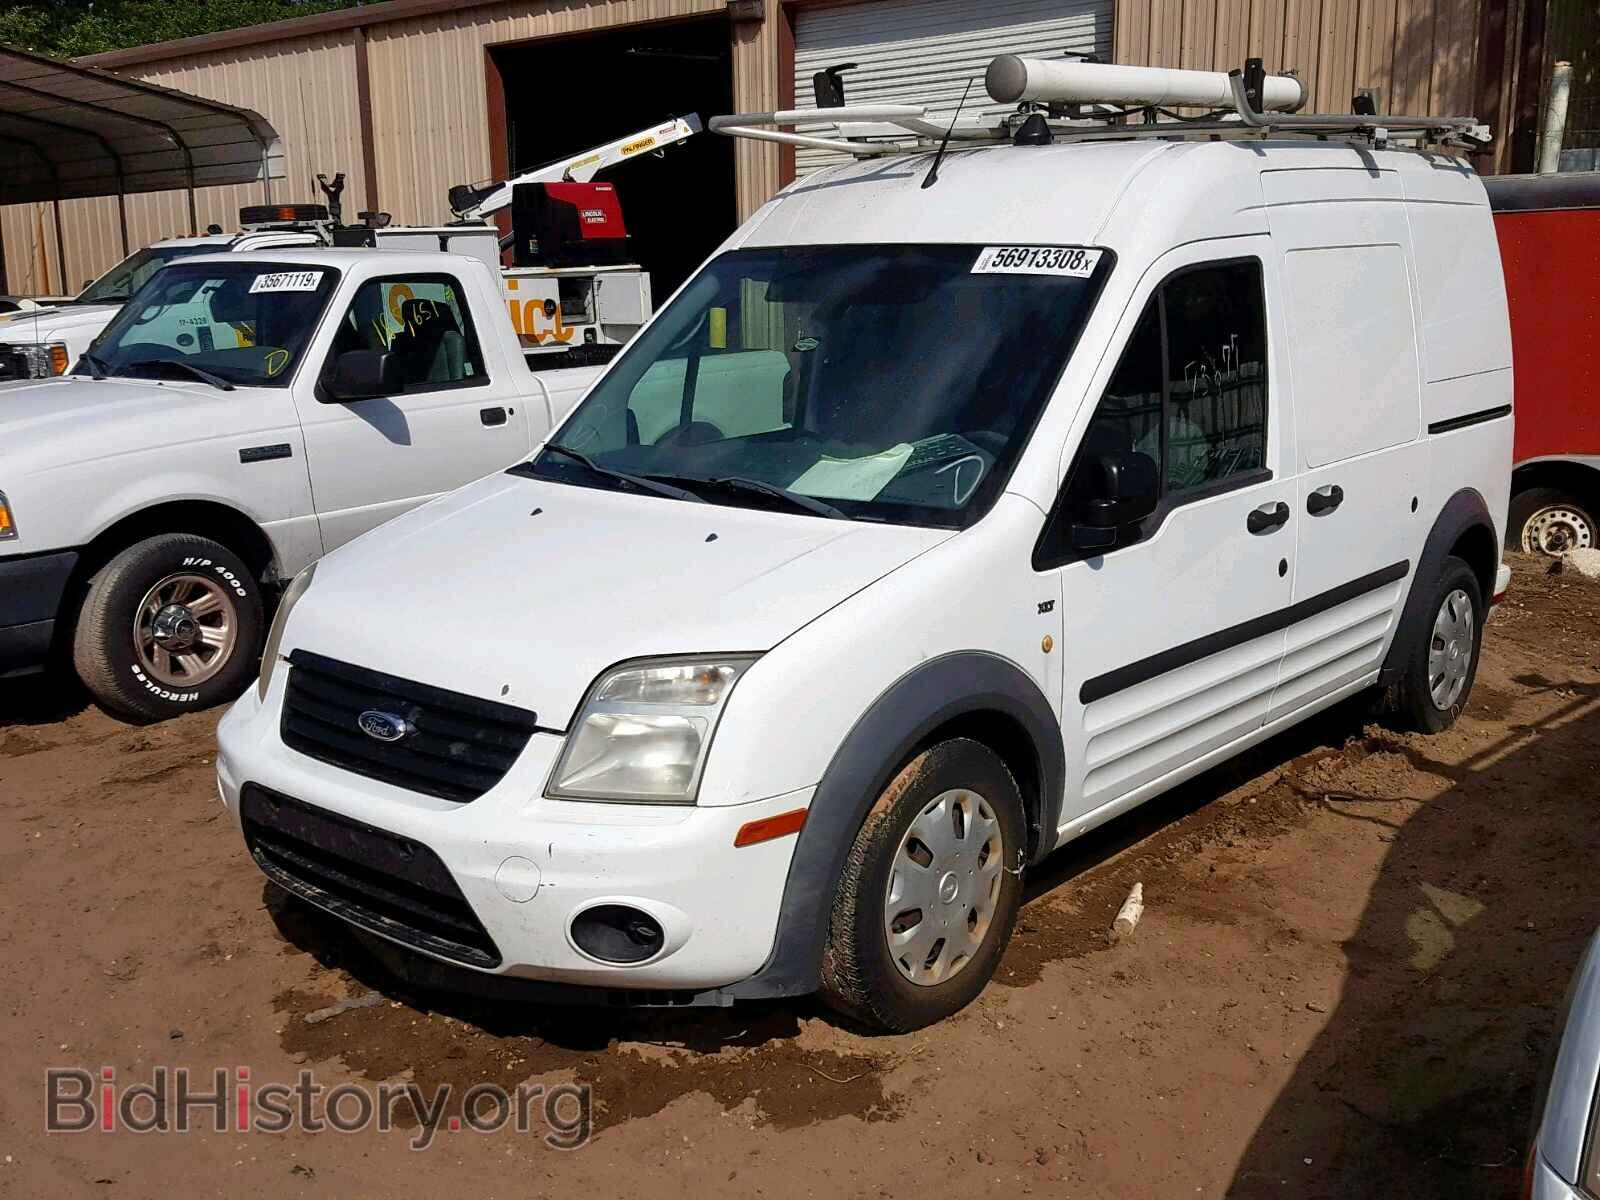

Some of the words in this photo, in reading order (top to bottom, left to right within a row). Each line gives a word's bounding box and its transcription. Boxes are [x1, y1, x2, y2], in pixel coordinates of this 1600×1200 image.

[182, 557, 212, 567] H/P
[214, 565, 247, 598] 4000
[131, 663, 199, 702] HERCULES
